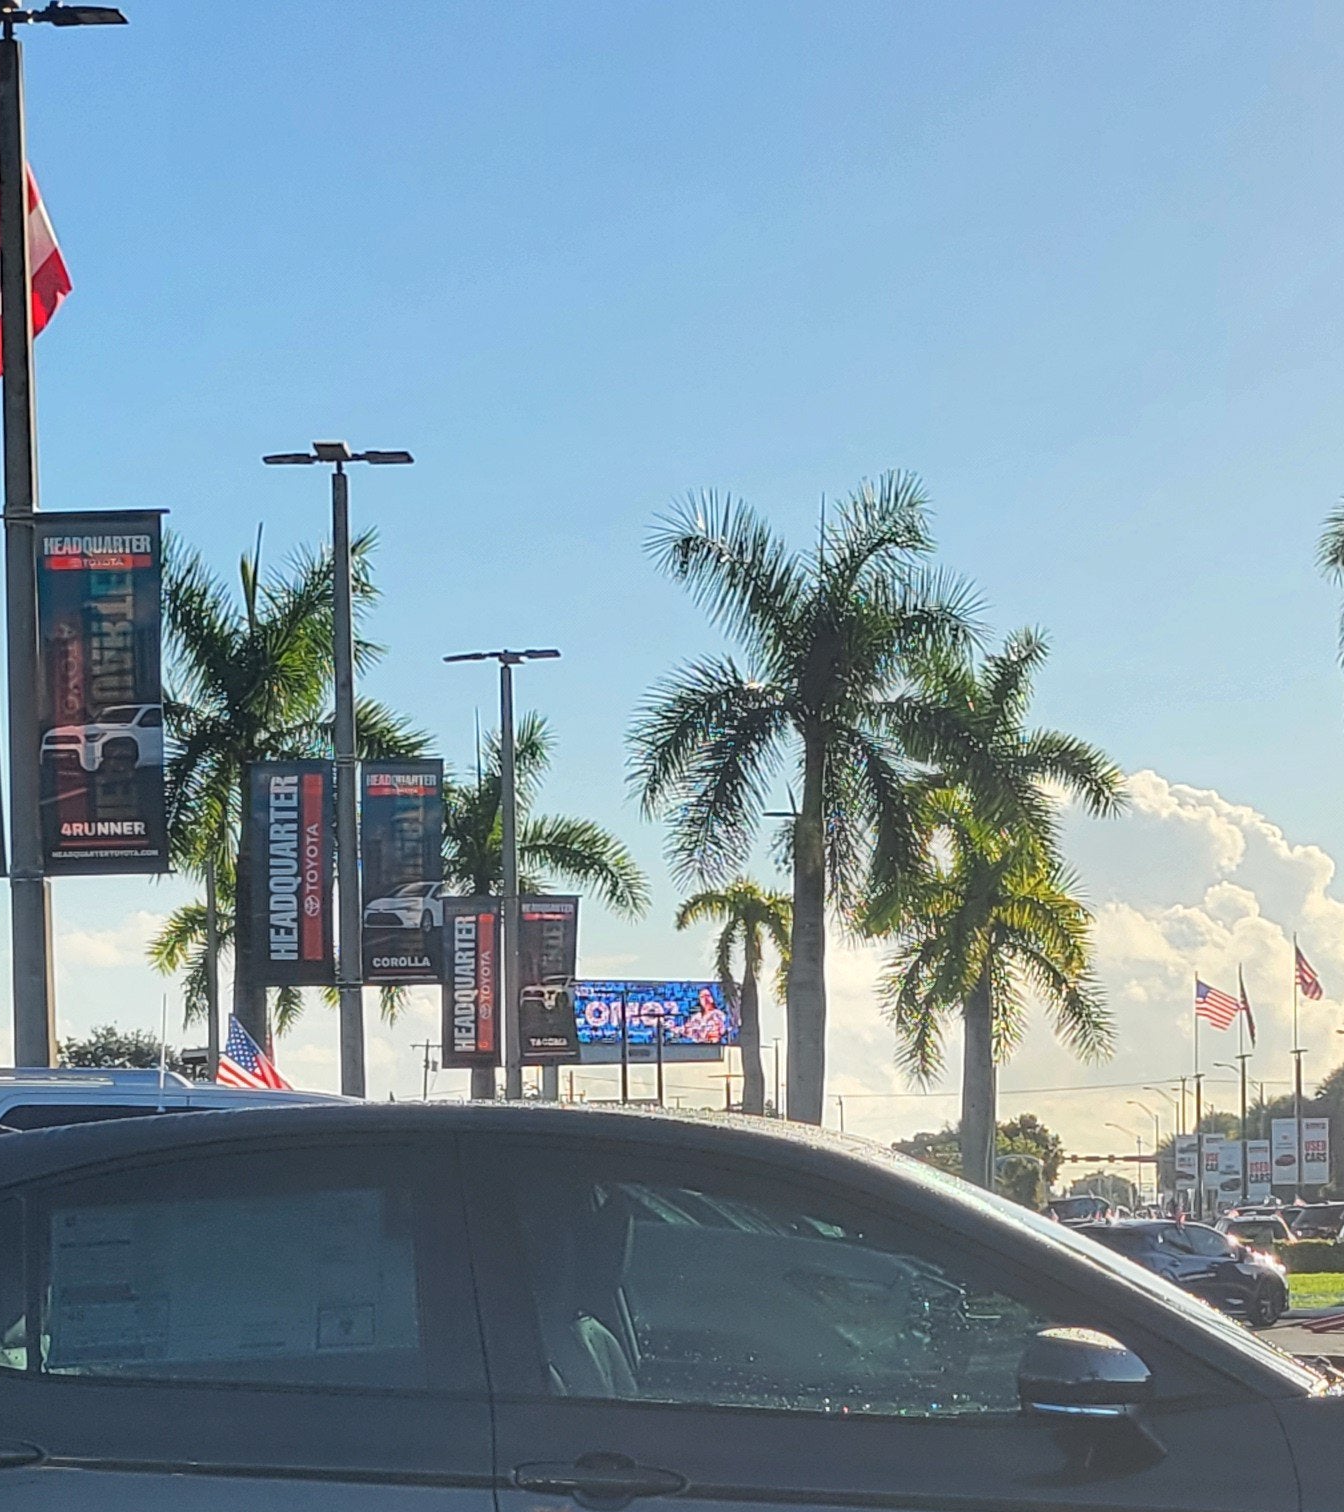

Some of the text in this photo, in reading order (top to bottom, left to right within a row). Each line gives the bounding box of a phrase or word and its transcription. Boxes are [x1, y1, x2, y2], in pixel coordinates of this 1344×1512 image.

[43, 534, 152, 556] HEADQUARTER
[60, 821, 146, 837] 4RUNNER
[269, 775, 302, 960] HEADQUARTER
[305, 823, 319, 892] TOYOTA
[372, 956, 431, 968] COROLLA
[454, 915, 478, 1052] HEADQUARTER
[480, 950, 492, 1003] TOYOTA
[1305, 1140, 1327, 1151] USED
[1305, 1152, 1327, 1163] CARS
